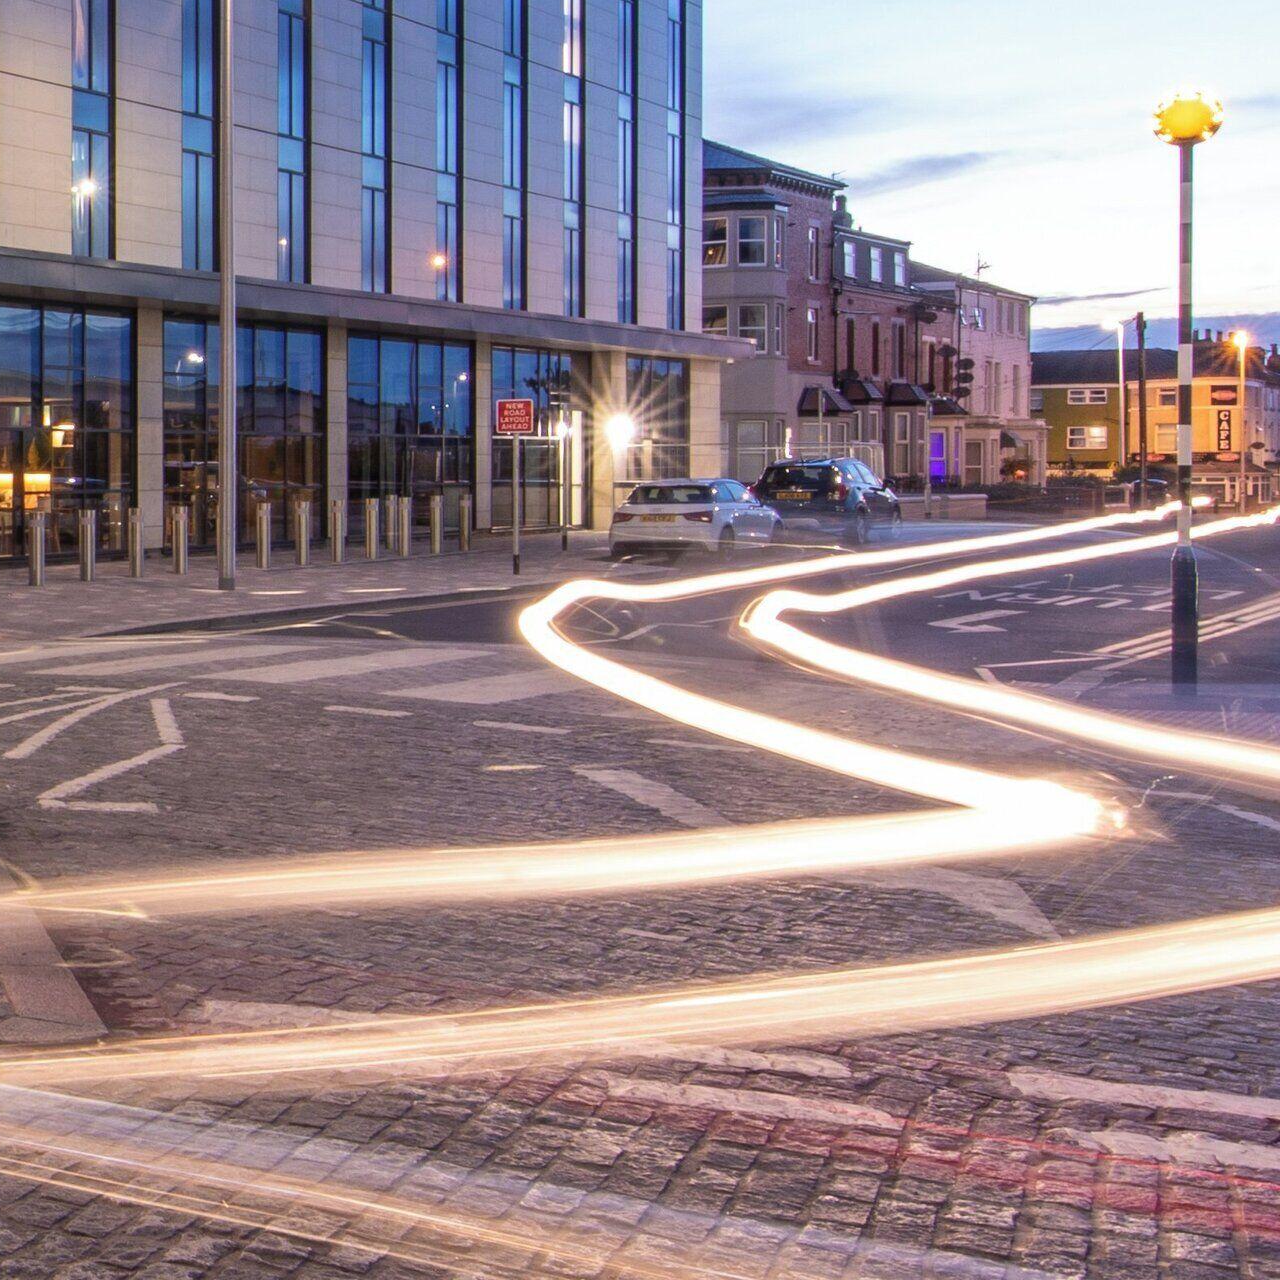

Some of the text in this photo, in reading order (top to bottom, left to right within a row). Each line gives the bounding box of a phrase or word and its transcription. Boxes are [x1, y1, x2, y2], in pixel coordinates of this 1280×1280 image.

[503, 409, 526, 417] ROAD
[500, 416, 530, 424] LAYOUT
[1219, 411, 1230, 450] CAFE
